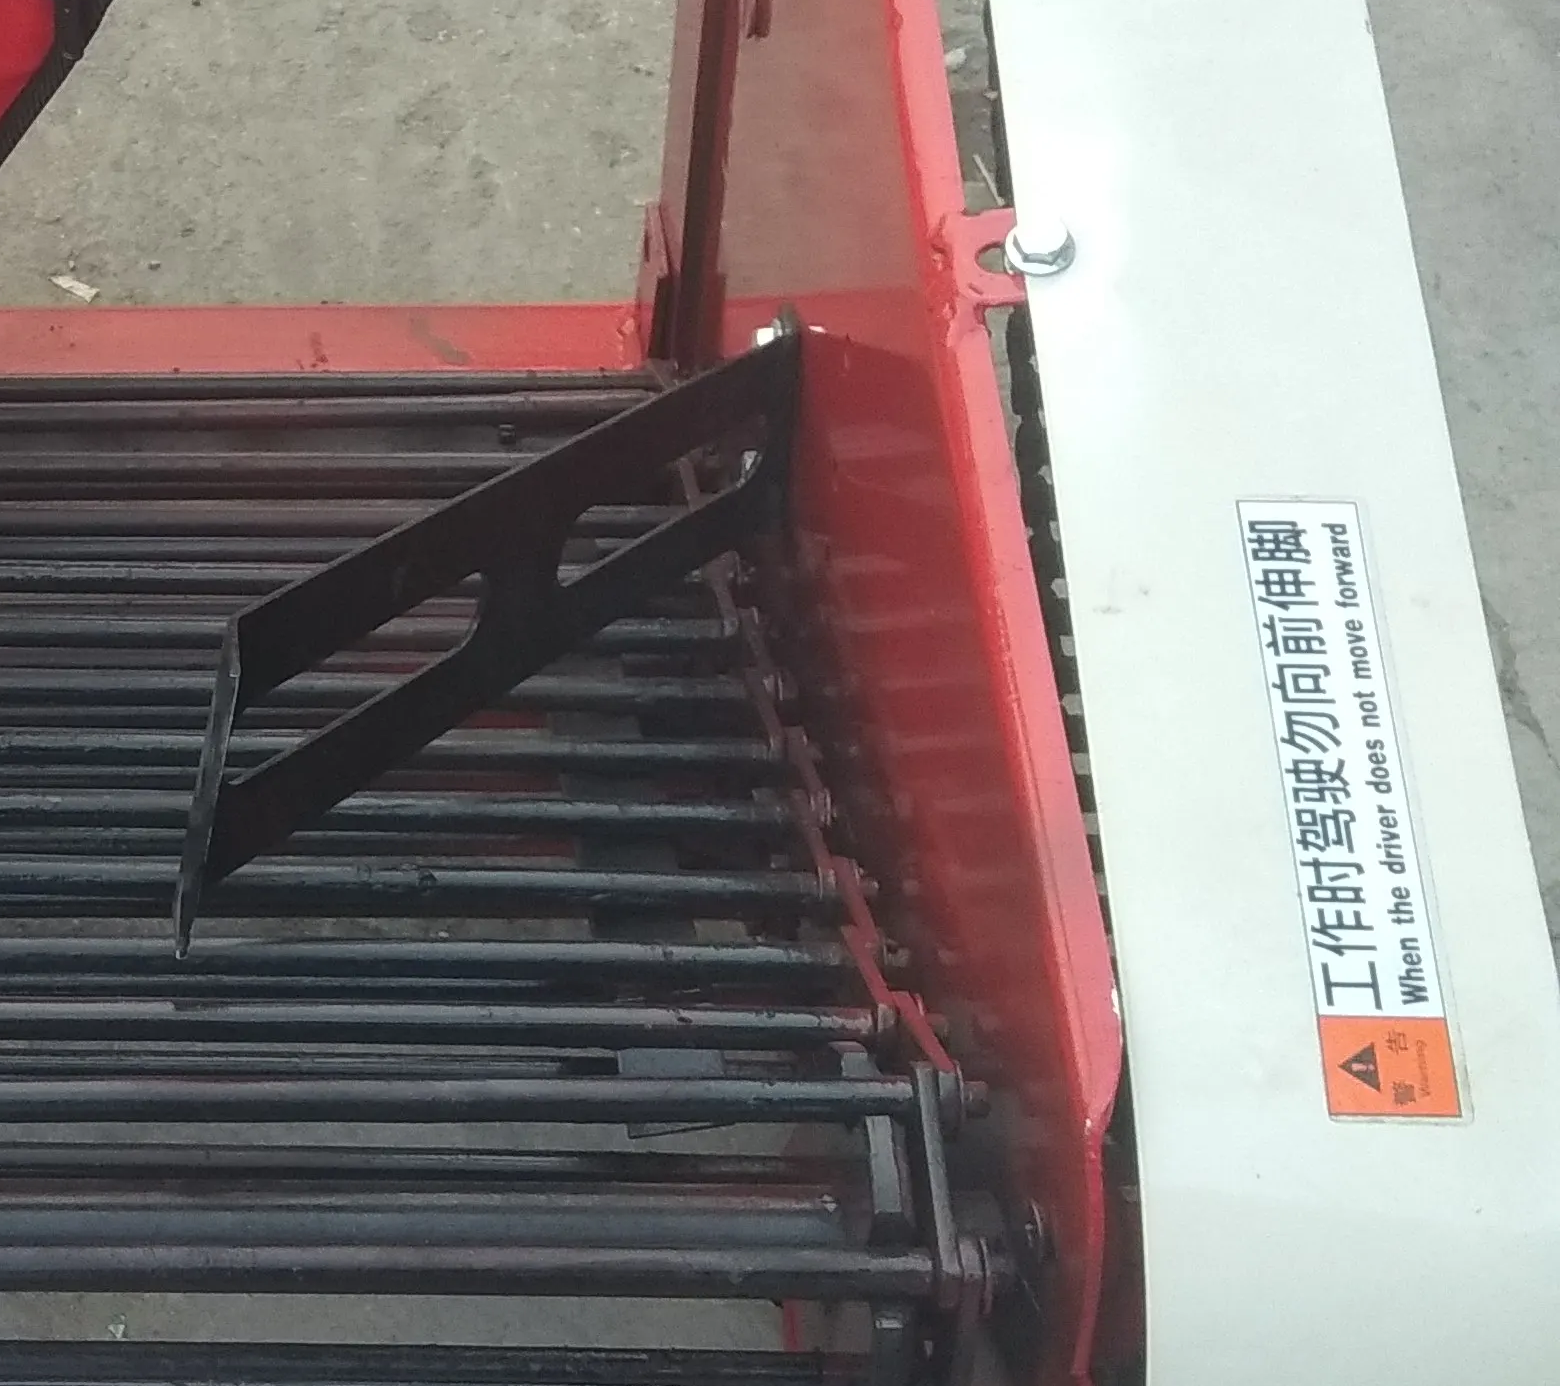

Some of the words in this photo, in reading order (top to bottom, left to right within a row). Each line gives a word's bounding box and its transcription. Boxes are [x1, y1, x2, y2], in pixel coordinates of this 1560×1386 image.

[1322, 522, 1360, 608] forward
[1341, 619, 1373, 680] move
[1353, 691, 1382, 728] not
[1247, 519, 1383, 1011] 工作时驾驶勿向前伸脚
[1362, 739, 1392, 794] does
[1371, 803, 1407, 874] driver
[1383, 886, 1415, 925] the
[1392, 936, 1430, 1005] When
